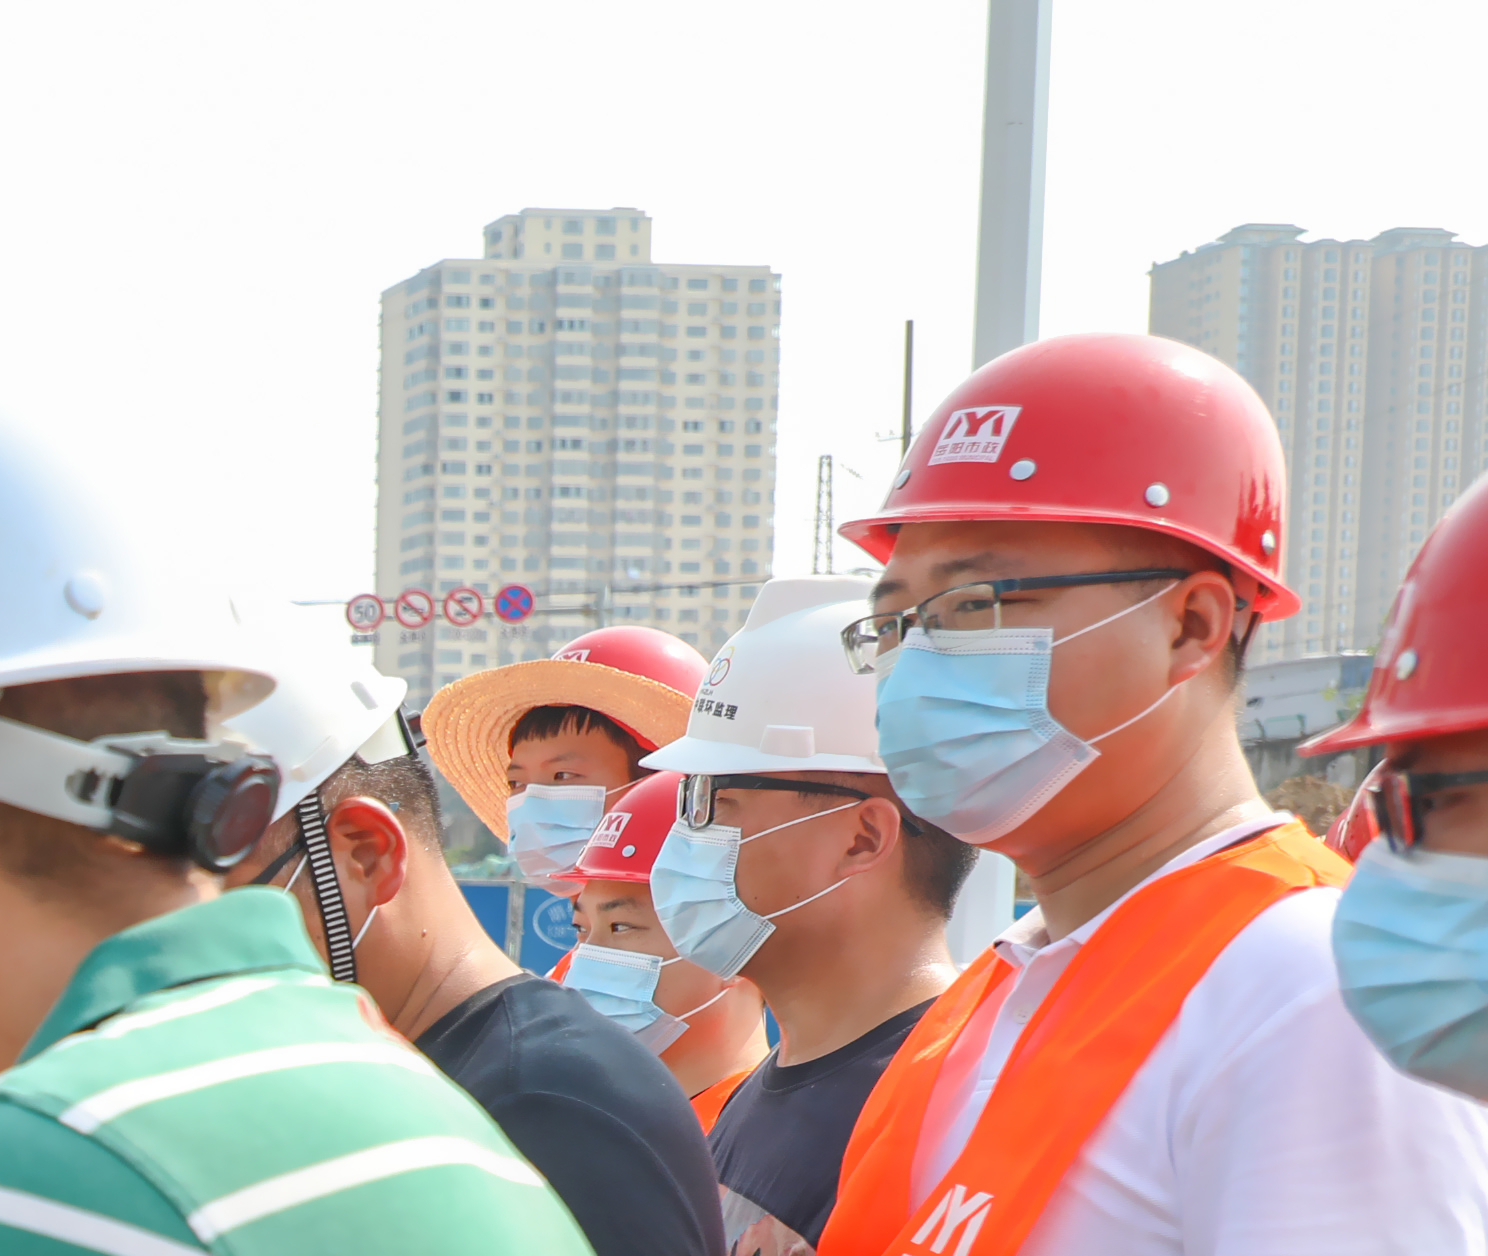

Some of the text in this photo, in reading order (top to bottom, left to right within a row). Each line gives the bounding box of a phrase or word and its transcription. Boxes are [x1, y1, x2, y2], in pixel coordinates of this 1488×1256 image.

[934, 442, 1001, 457] 岳阳市政
[353, 604, 377, 623] 50
